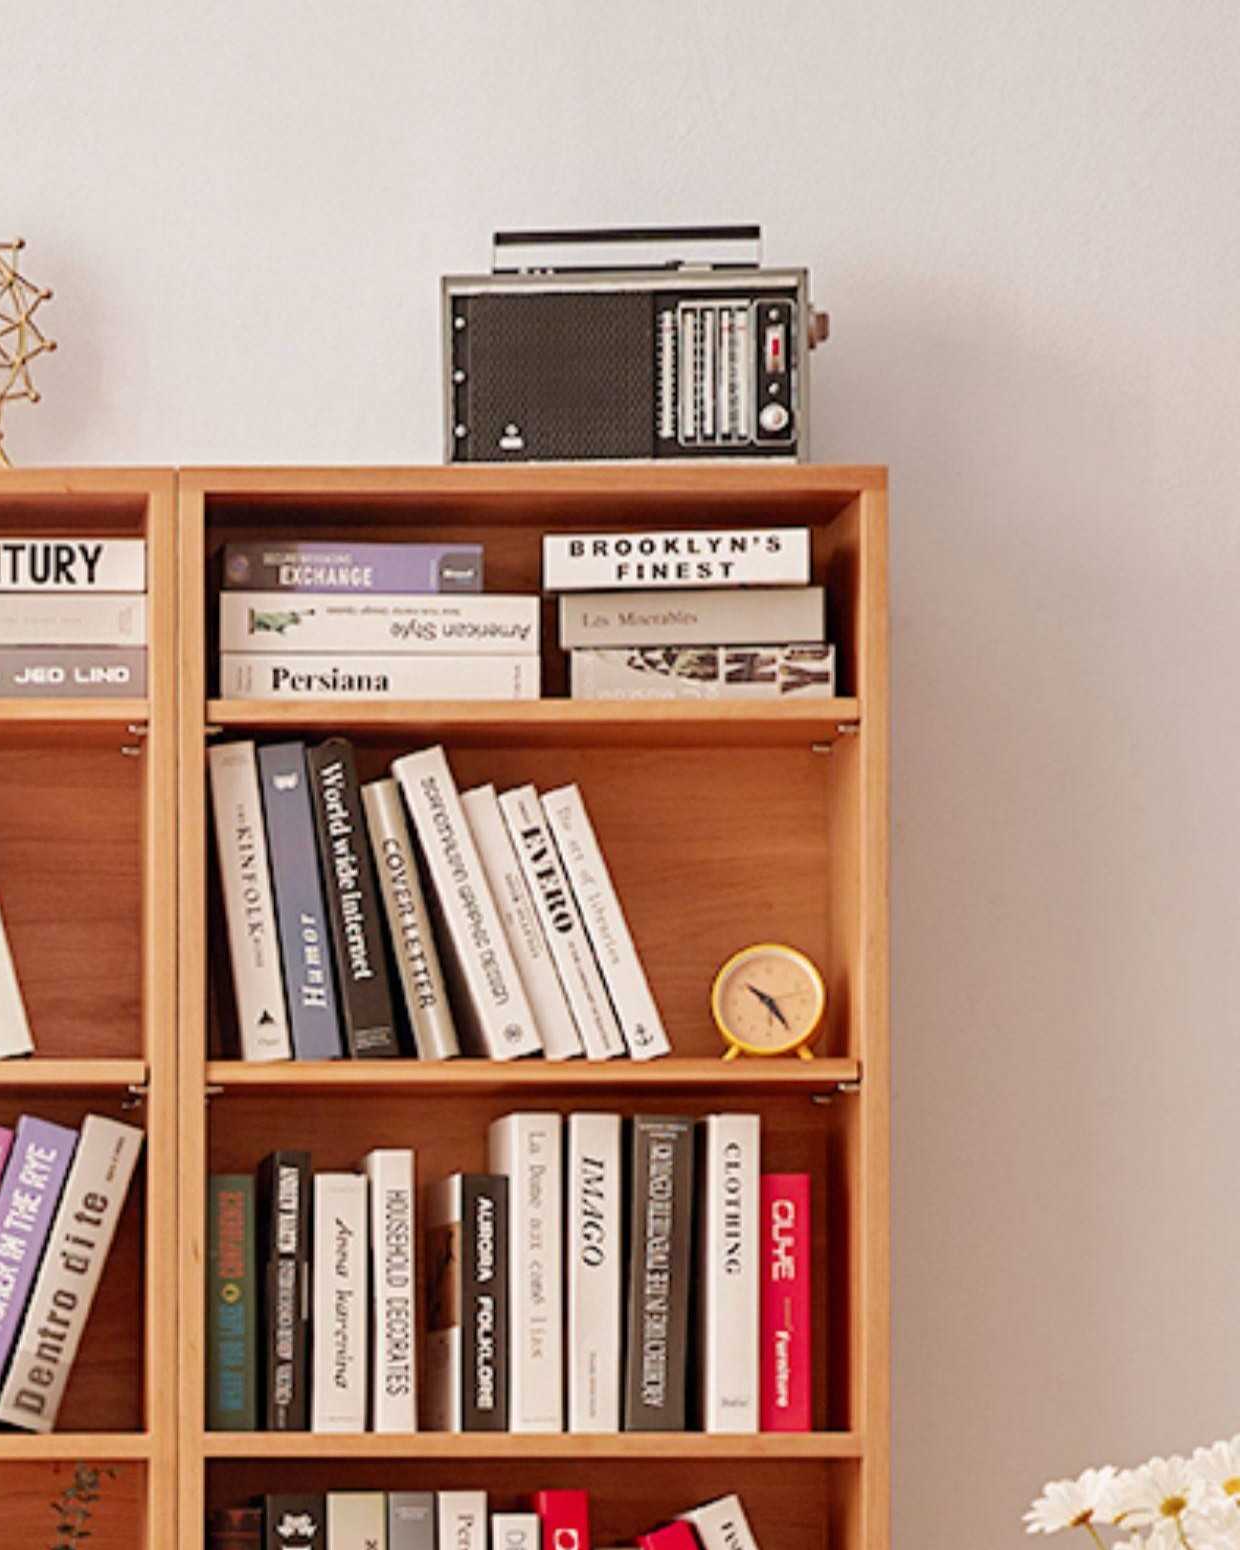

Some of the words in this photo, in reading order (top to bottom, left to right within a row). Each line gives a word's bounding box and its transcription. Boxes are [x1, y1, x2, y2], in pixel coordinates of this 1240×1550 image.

[279, 564, 374, 589] EXCHANGE
[569, 535, 784, 558] BROOKLYN'S
[616, 561, 736, 581] FINEST
[389, 620, 437, 641] Style
[442, 623, 531, 640] American
[271, 666, 390, 694] Persiana
[319, 761, 353, 835] World
[235, 827, 263, 937] KINFOLK
[332, 839, 361, 890] wide
[520, 825, 574, 935] EVERO
[300, 913, 329, 1008] Humor
[340, 891, 374, 981] Internet
[381, 838, 413, 919] COVER
[402, 923, 437, 1010] LETTER
[459, 884, 491, 949] GRAPHIC
[478, 952, 509, 1007] DESIGN
[23, 1141, 57, 1190] RYE
[4, 1188, 44, 1233] THE
[73, 1191, 109, 1227] te
[335, 1217, 355, 1278] Anna
[385, 1189, 409, 1289] HOUSEHOLD
[476, 1197, 494, 1282] AURORA
[581, 1156, 605, 1268] IMAGO
[724, 1142, 742, 1276] CLOTHING
[58, 1232, 96, 1275] di
[12, 1289, 78, 1415] Dentro
[385, 1297, 409, 1398] DECORATES
[476, 1296, 494, 1410] FOLKLORE
